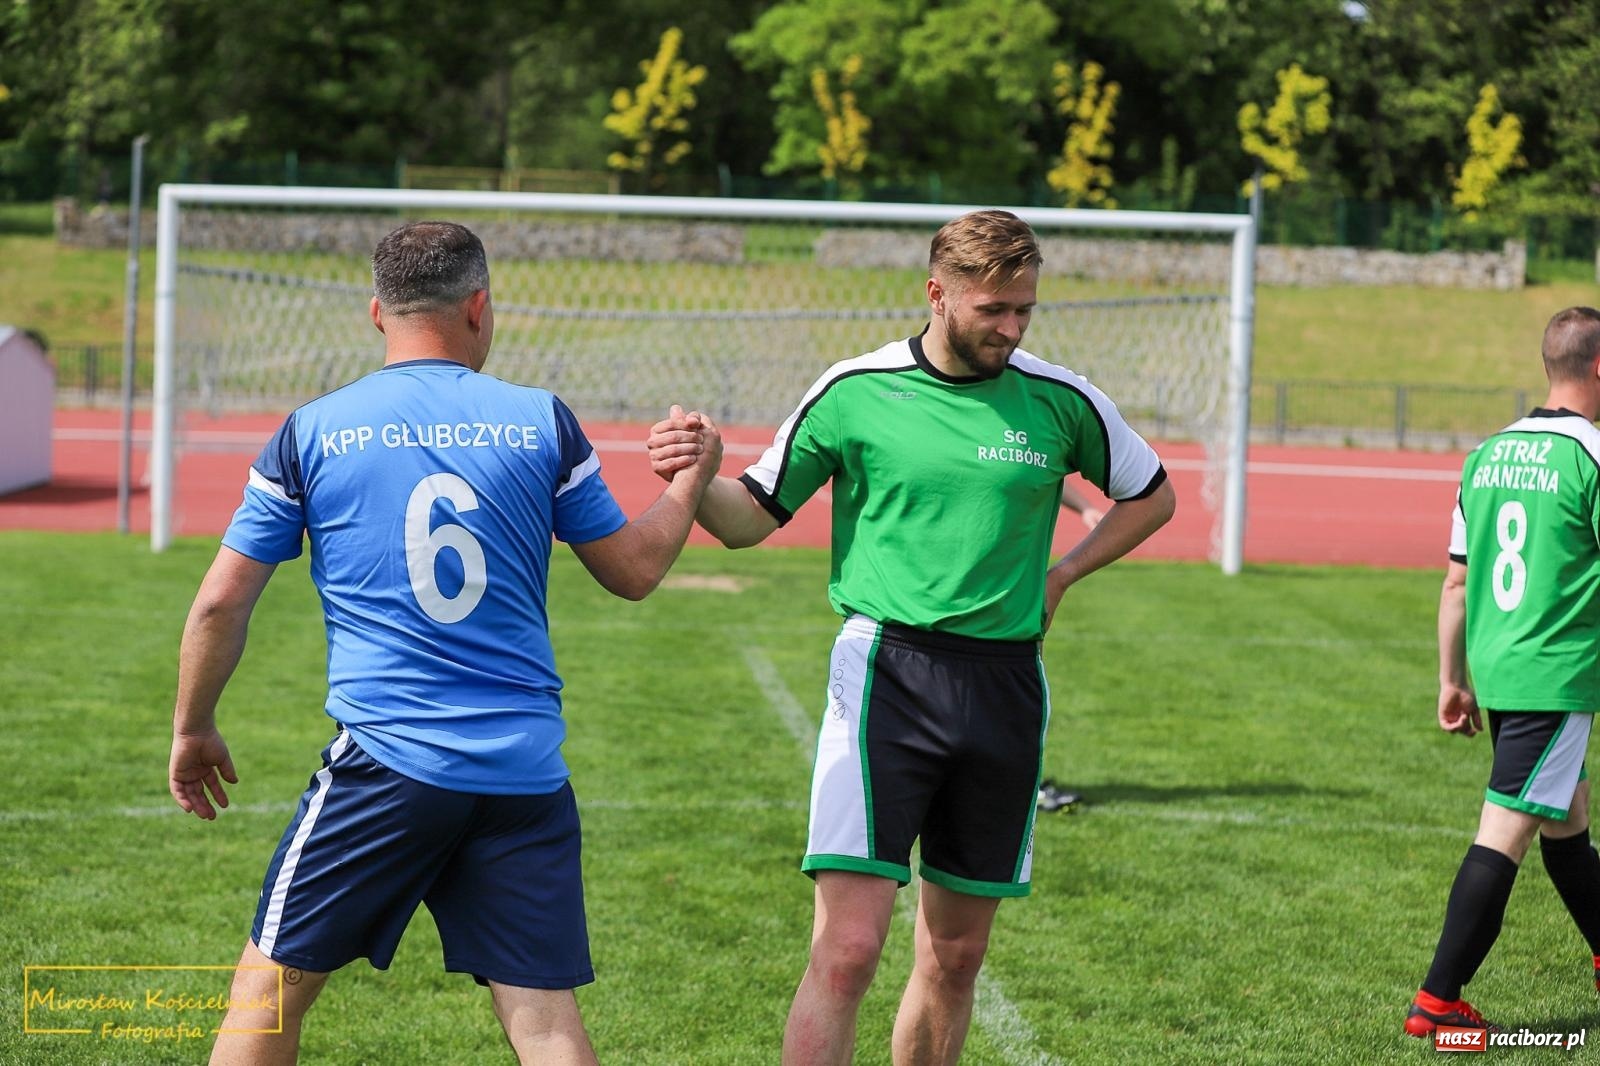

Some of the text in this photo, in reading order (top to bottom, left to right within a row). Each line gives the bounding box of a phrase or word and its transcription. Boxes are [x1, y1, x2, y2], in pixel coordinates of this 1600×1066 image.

[321, 422, 539, 457] KPP GŁUBCZYCE
[1003, 429, 1027, 445] SG
[1490, 438, 1552, 464] STRAŻ
[977, 446, 1047, 468] RACIBÓRZ
[1472, 464, 1559, 494] GRANICZNA
[404, 472, 488, 624] 6
[1492, 500, 1528, 613] 8
